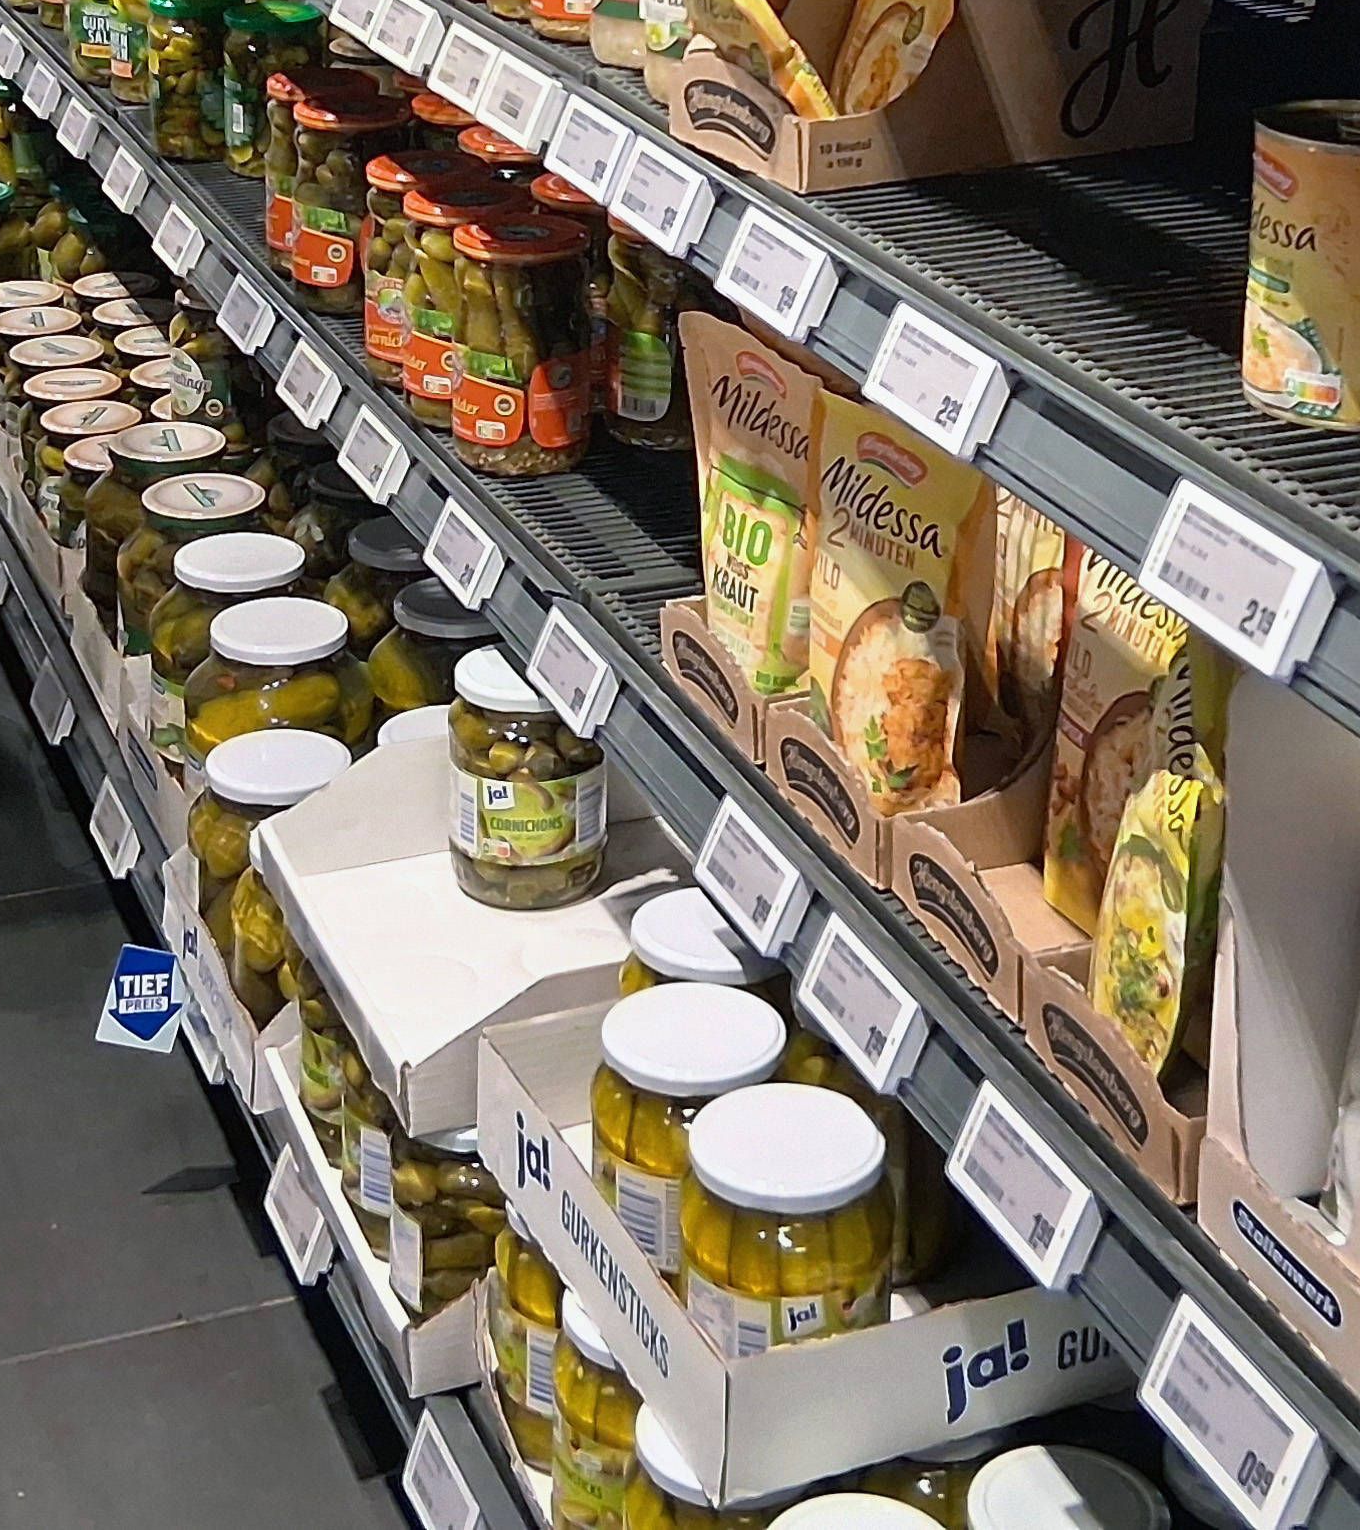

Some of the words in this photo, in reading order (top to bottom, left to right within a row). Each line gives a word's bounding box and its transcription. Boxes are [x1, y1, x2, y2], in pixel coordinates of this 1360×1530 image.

[711, 374, 810, 462] Mildessa
[821, 455, 944, 559] Mildessa
[721, 502, 773, 567] BIO
[826, 506, 851, 549] 2
[848, 521, 917, 571] MINUTEN
[711, 566, 759, 614] KRAUT
[486, 785, 509, 806] ja!
[490, 816, 563, 833] CORNICHONS
[119, 973, 170, 998] TIEF
[124, 997, 164, 1012] PREIS
[515, 1110, 552, 1192] ja!
[560, 1189, 670, 1379] GURKENSTICKS
[787, 1302, 818, 1333] ja!
[941, 1318, 1031, 1425] ja!
[1236, 1449, 1275, 1497] 0.99
